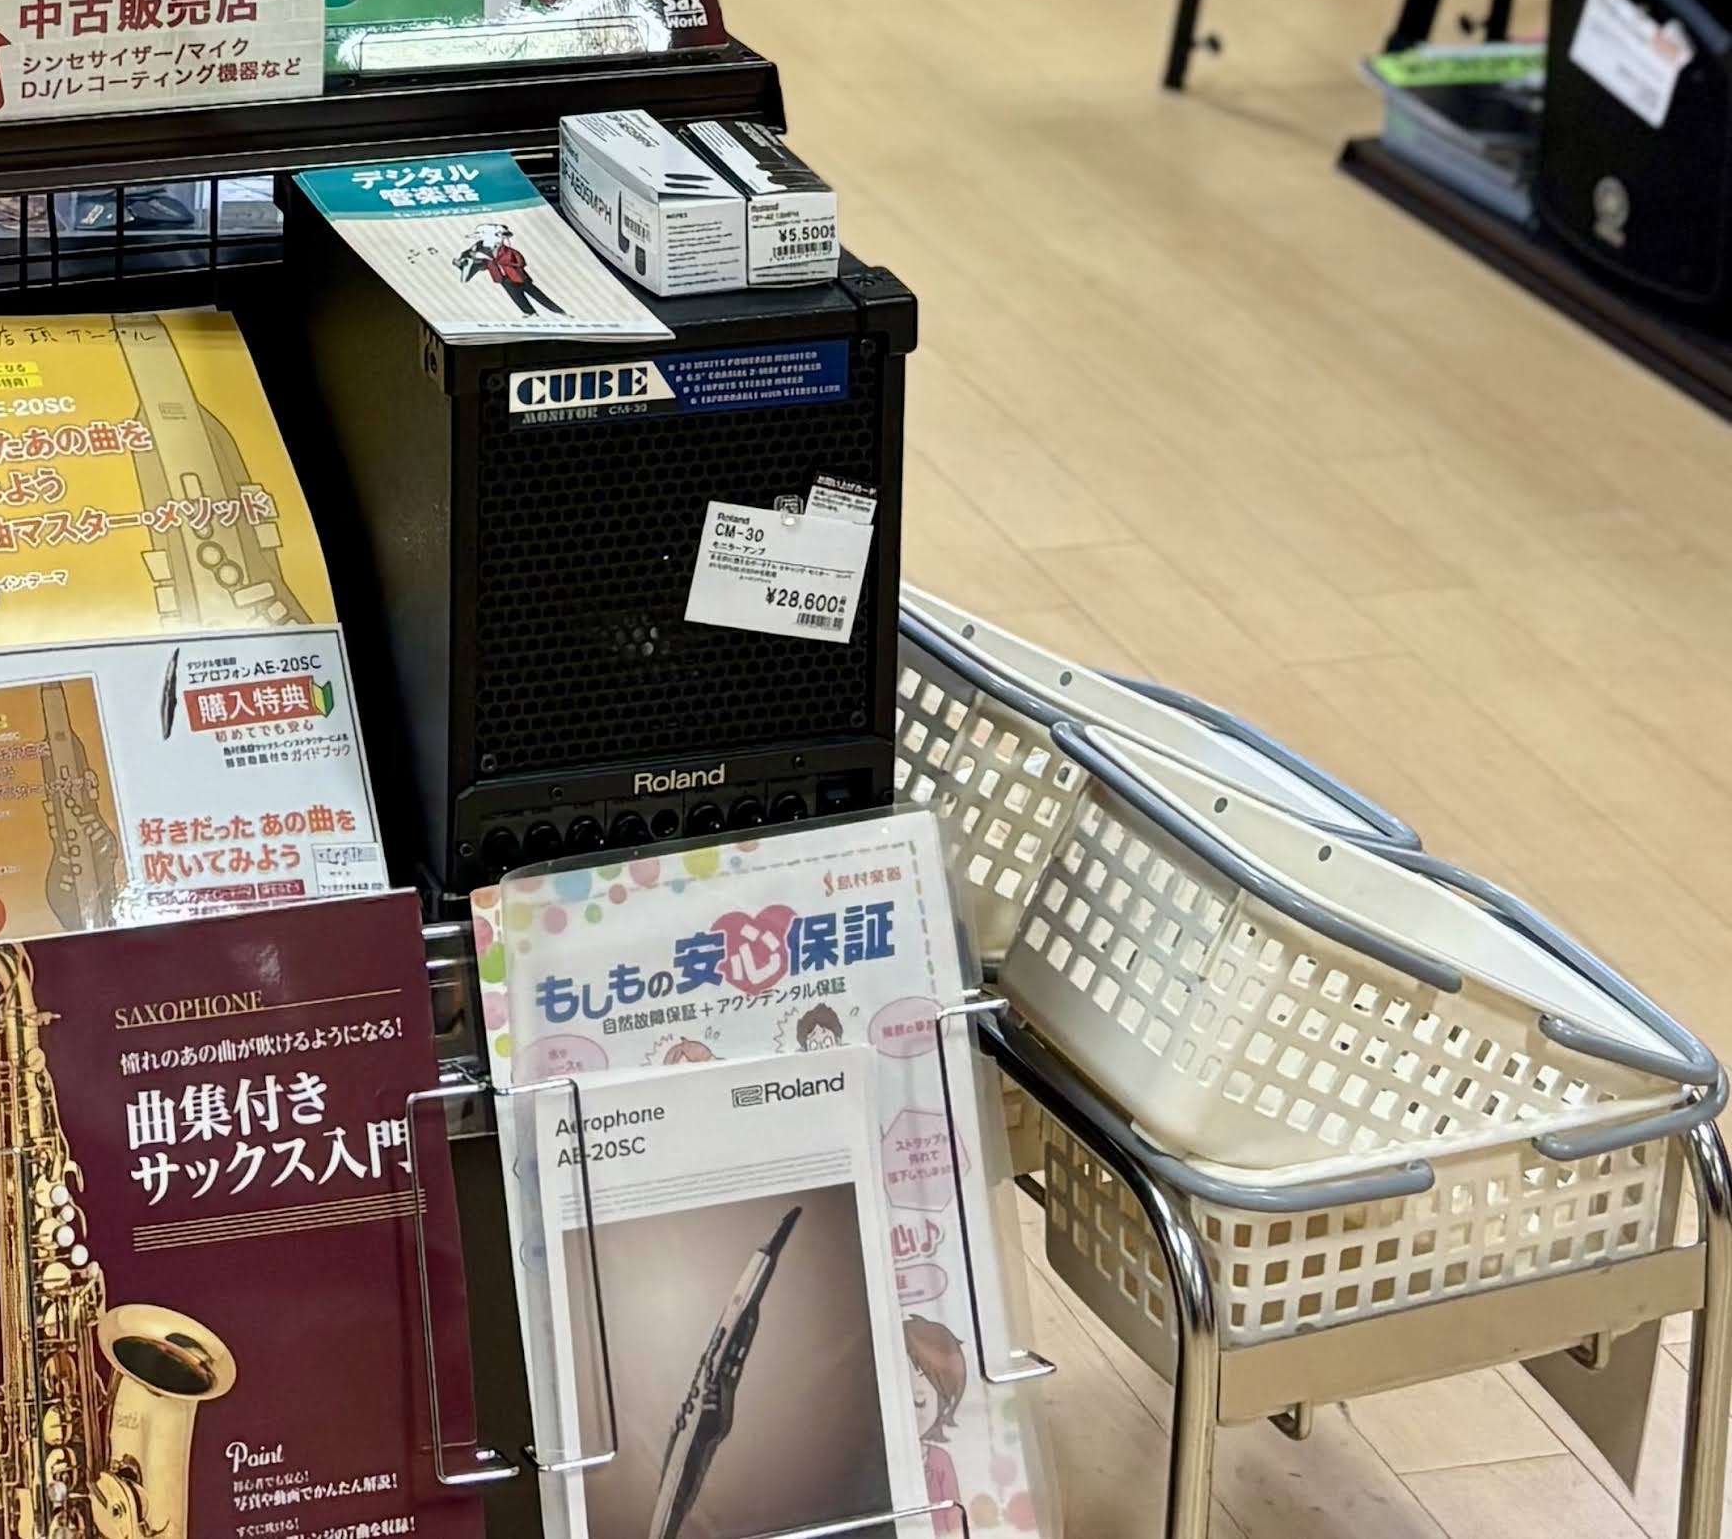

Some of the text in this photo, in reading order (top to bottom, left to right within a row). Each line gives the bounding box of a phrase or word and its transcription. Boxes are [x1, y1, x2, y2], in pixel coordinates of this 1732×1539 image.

[665, 14, 708, 29] World
[23, 37, 249, 74] シンセサイザー/マイク
[351, 164, 480, 189] デジタル
[379, 183, 480, 207] 管楽器
[779, 225, 829, 242] ¥5,500
[517, 367, 648, 406] CUBE
[522, 407, 598, 424] MONITOR
[714, 524, 764, 543] CM-30
[717, 512, 750, 526] Roland
[765, 586, 841, 614] ¥28,600
[189, 655, 322, 684] エアロフォン AE-20SC
[198, 684, 309, 724] 購入特典
[634, 763, 725, 795] Roland
[139, 804, 356, 845] 好きだった あの曲を
[143, 843, 301, 884] 吹いてみよう
[836, 864, 903, 892] 島村楽器
[535, 901, 896, 1024] もしもの安心保証
[115, 990, 264, 1029] SAXOPHONE
[120, 1017, 404, 1077] 憧れのあの曲が吹けるようになる!
[764, 1072, 845, 1105] Roland
[125, 1070, 329, 1151] 曲集付き
[130, 1115, 416, 1206] サックス入門
[225, 1441, 284, 1473] Point
